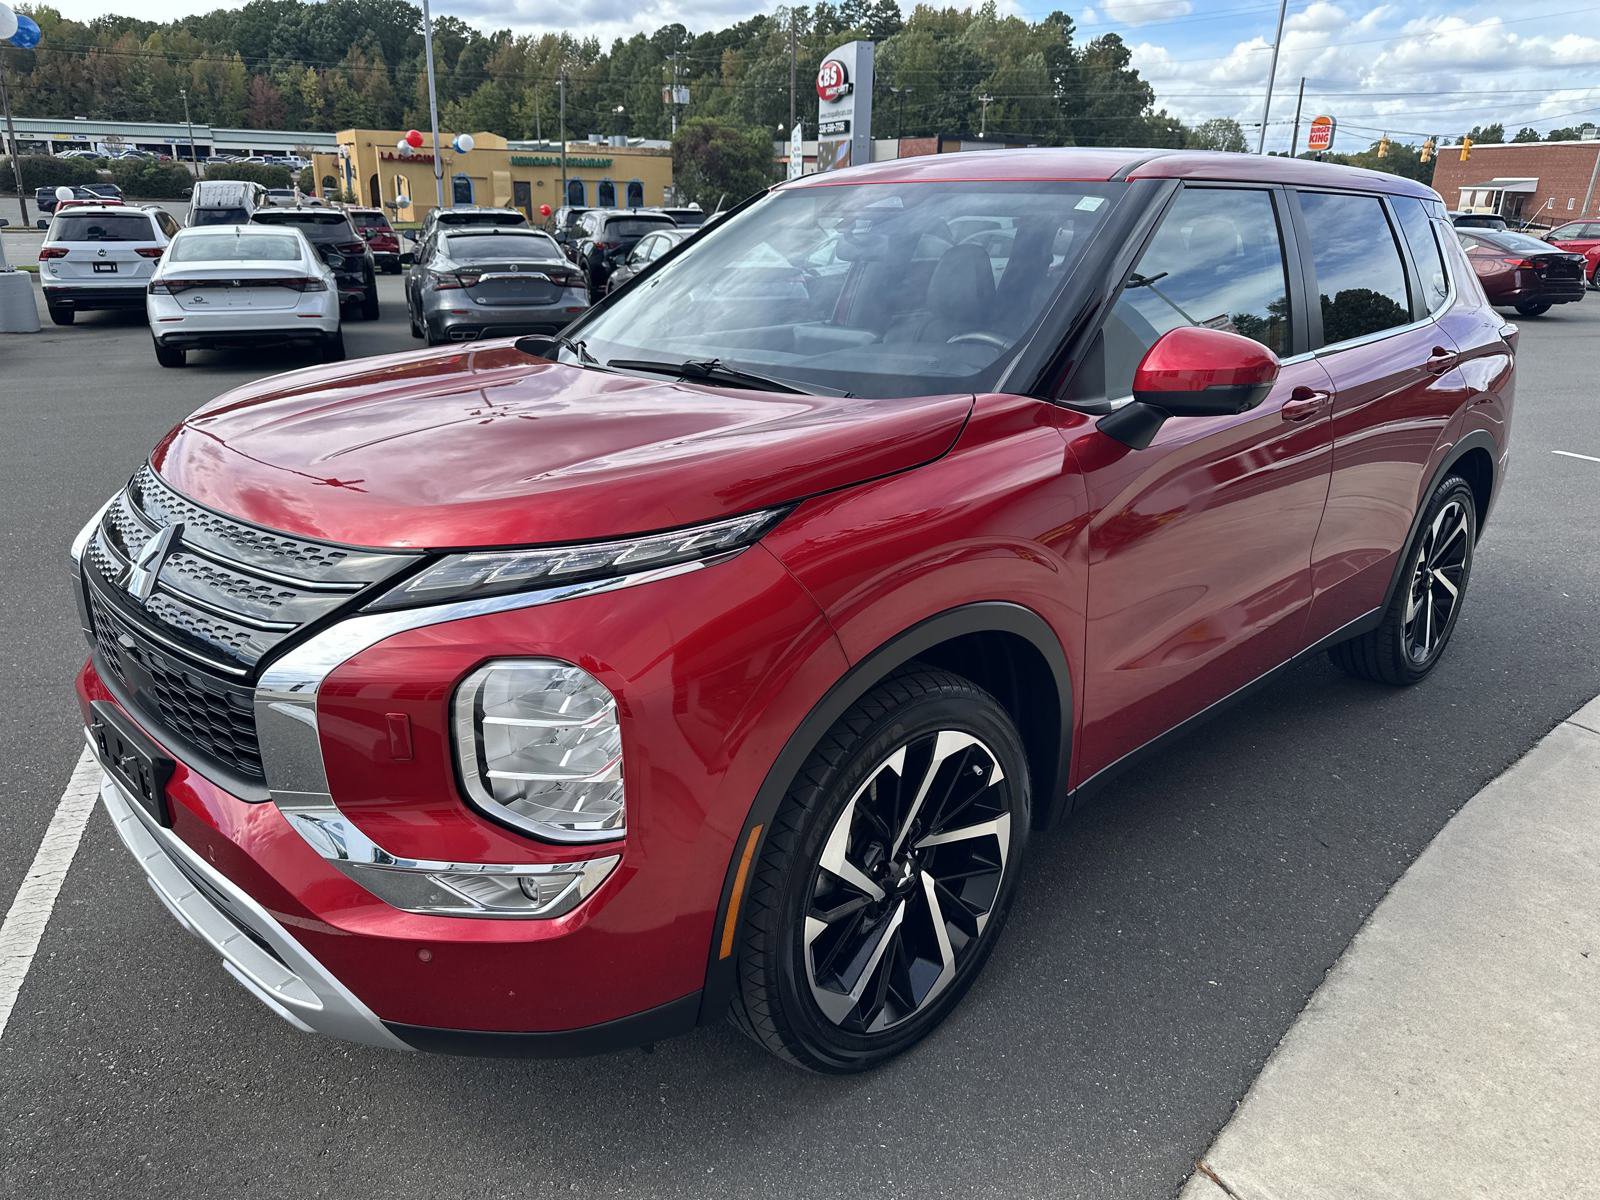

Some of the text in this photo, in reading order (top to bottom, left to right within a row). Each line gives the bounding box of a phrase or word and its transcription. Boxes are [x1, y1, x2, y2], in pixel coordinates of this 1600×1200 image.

[818, 65, 837, 87] CBS
[1311, 125, 1330, 133] BURGER
[1309, 133, 1329, 143] KING
[380, 151, 395, 161] LA
